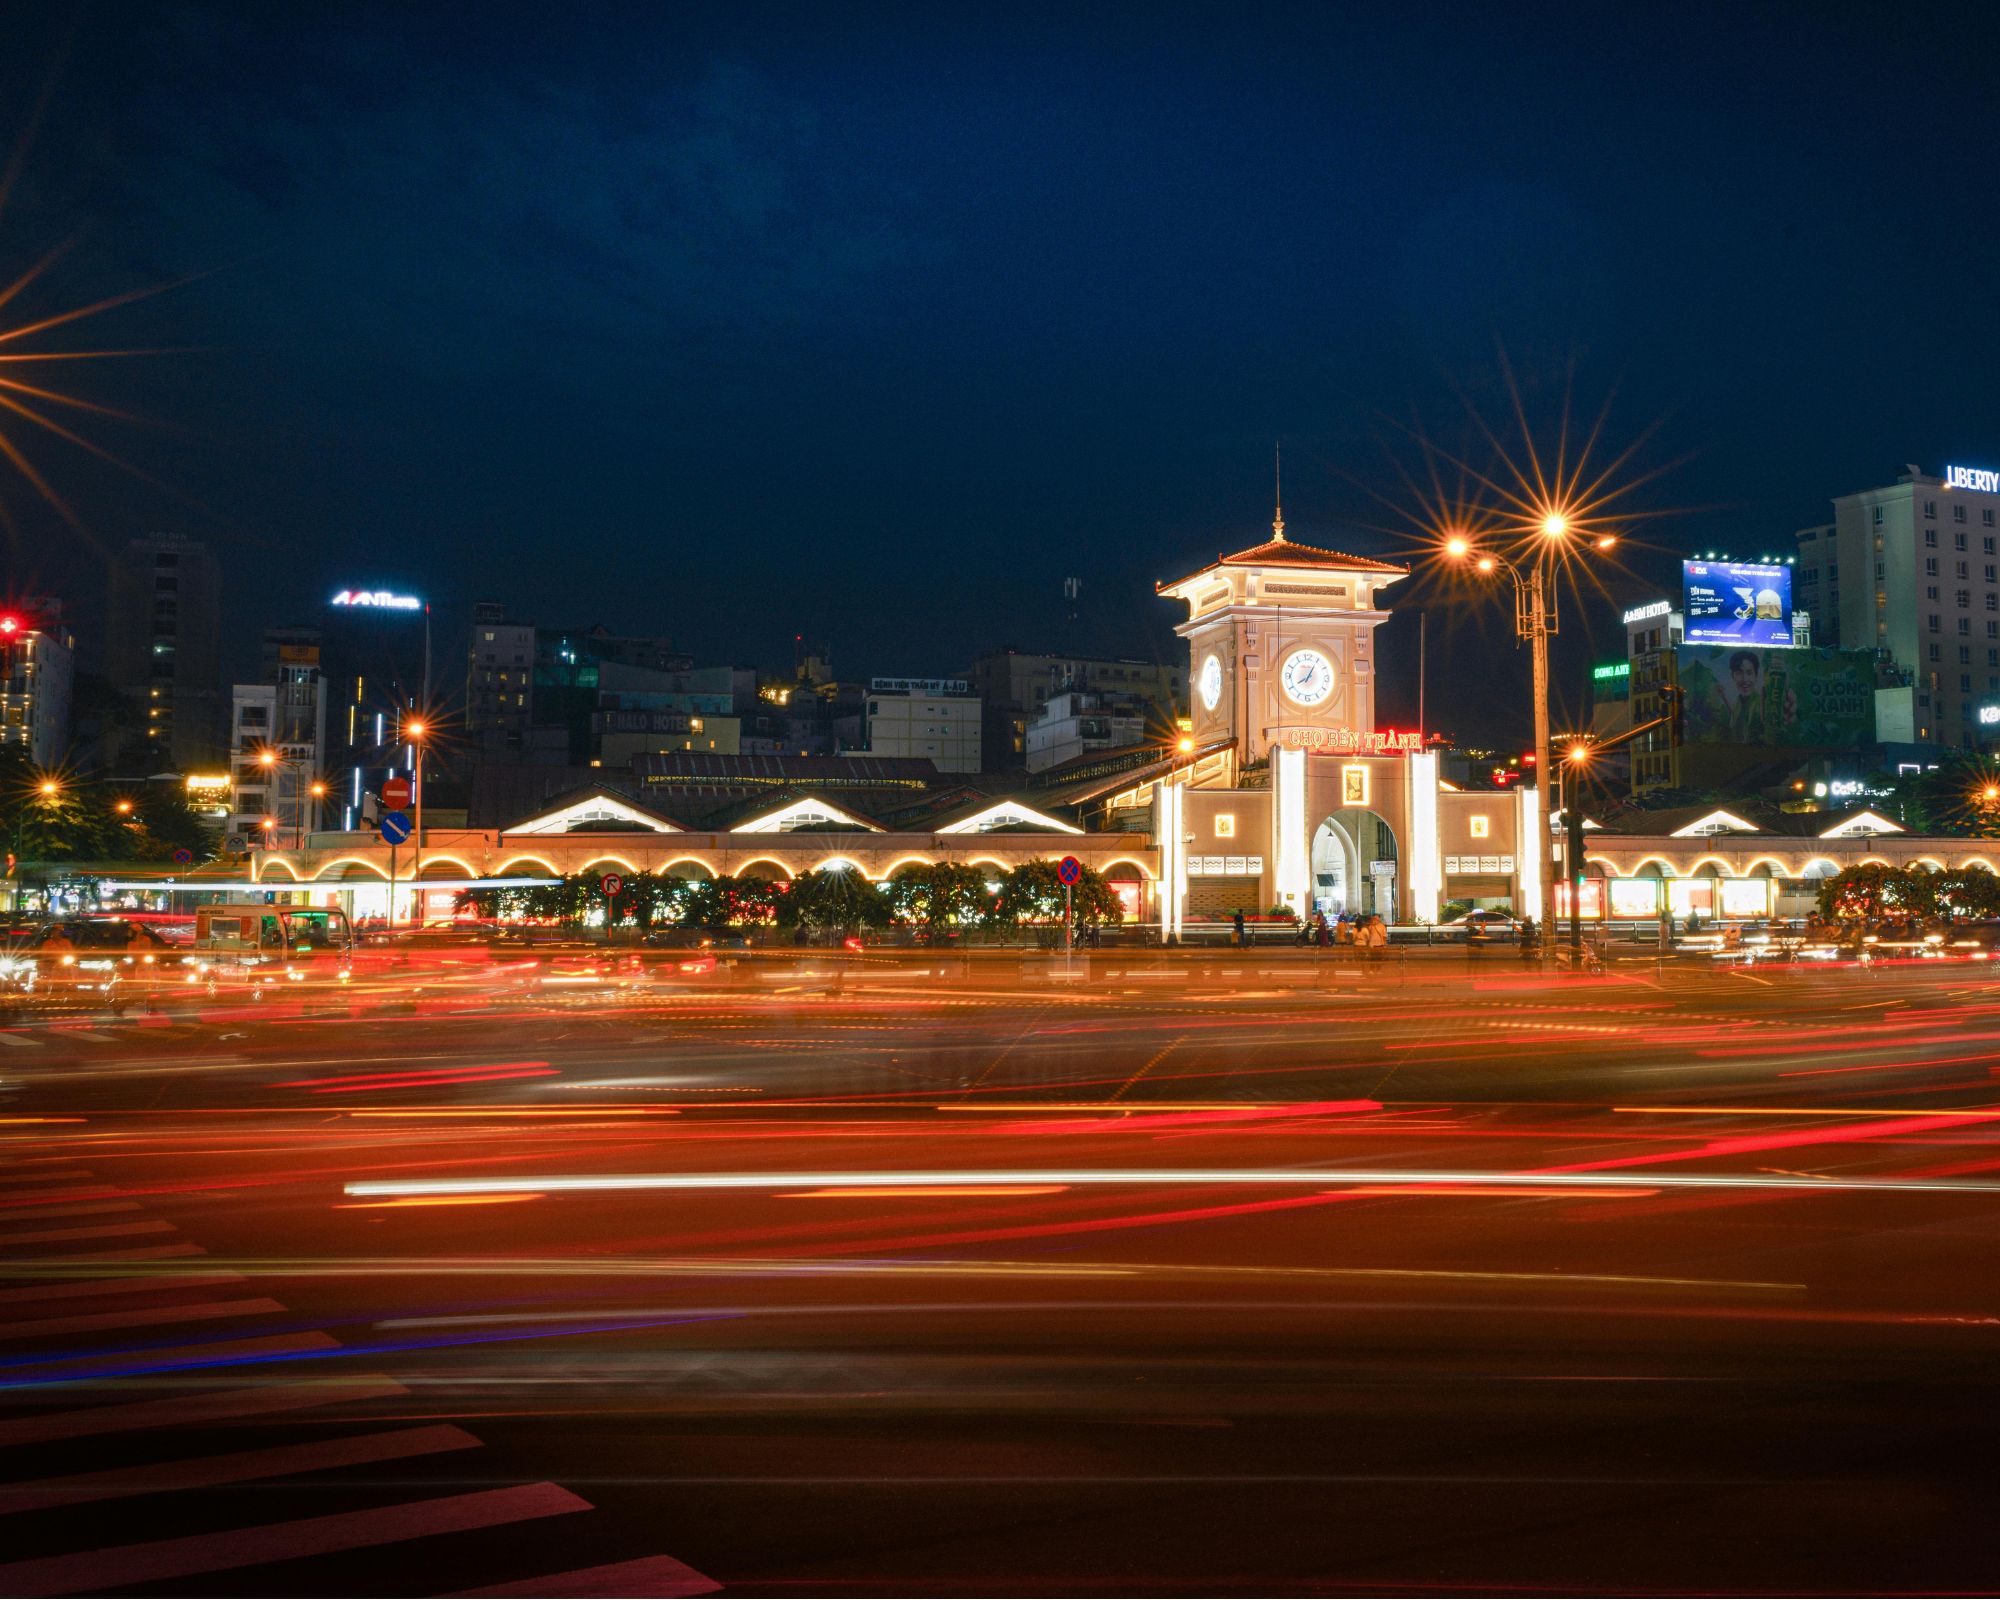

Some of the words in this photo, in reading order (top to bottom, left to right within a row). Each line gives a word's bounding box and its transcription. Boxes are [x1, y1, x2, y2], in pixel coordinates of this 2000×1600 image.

[1947, 465, 1999, 492] LIBERTY
[332, 591, 392, 606] AVANTI
[1646, 601, 1672, 617] HOTEL
[1290, 729, 1323, 748] CHỢ
[1328, 727, 1360, 748] BẾN
[1364, 729, 1421, 749] THÀNH
